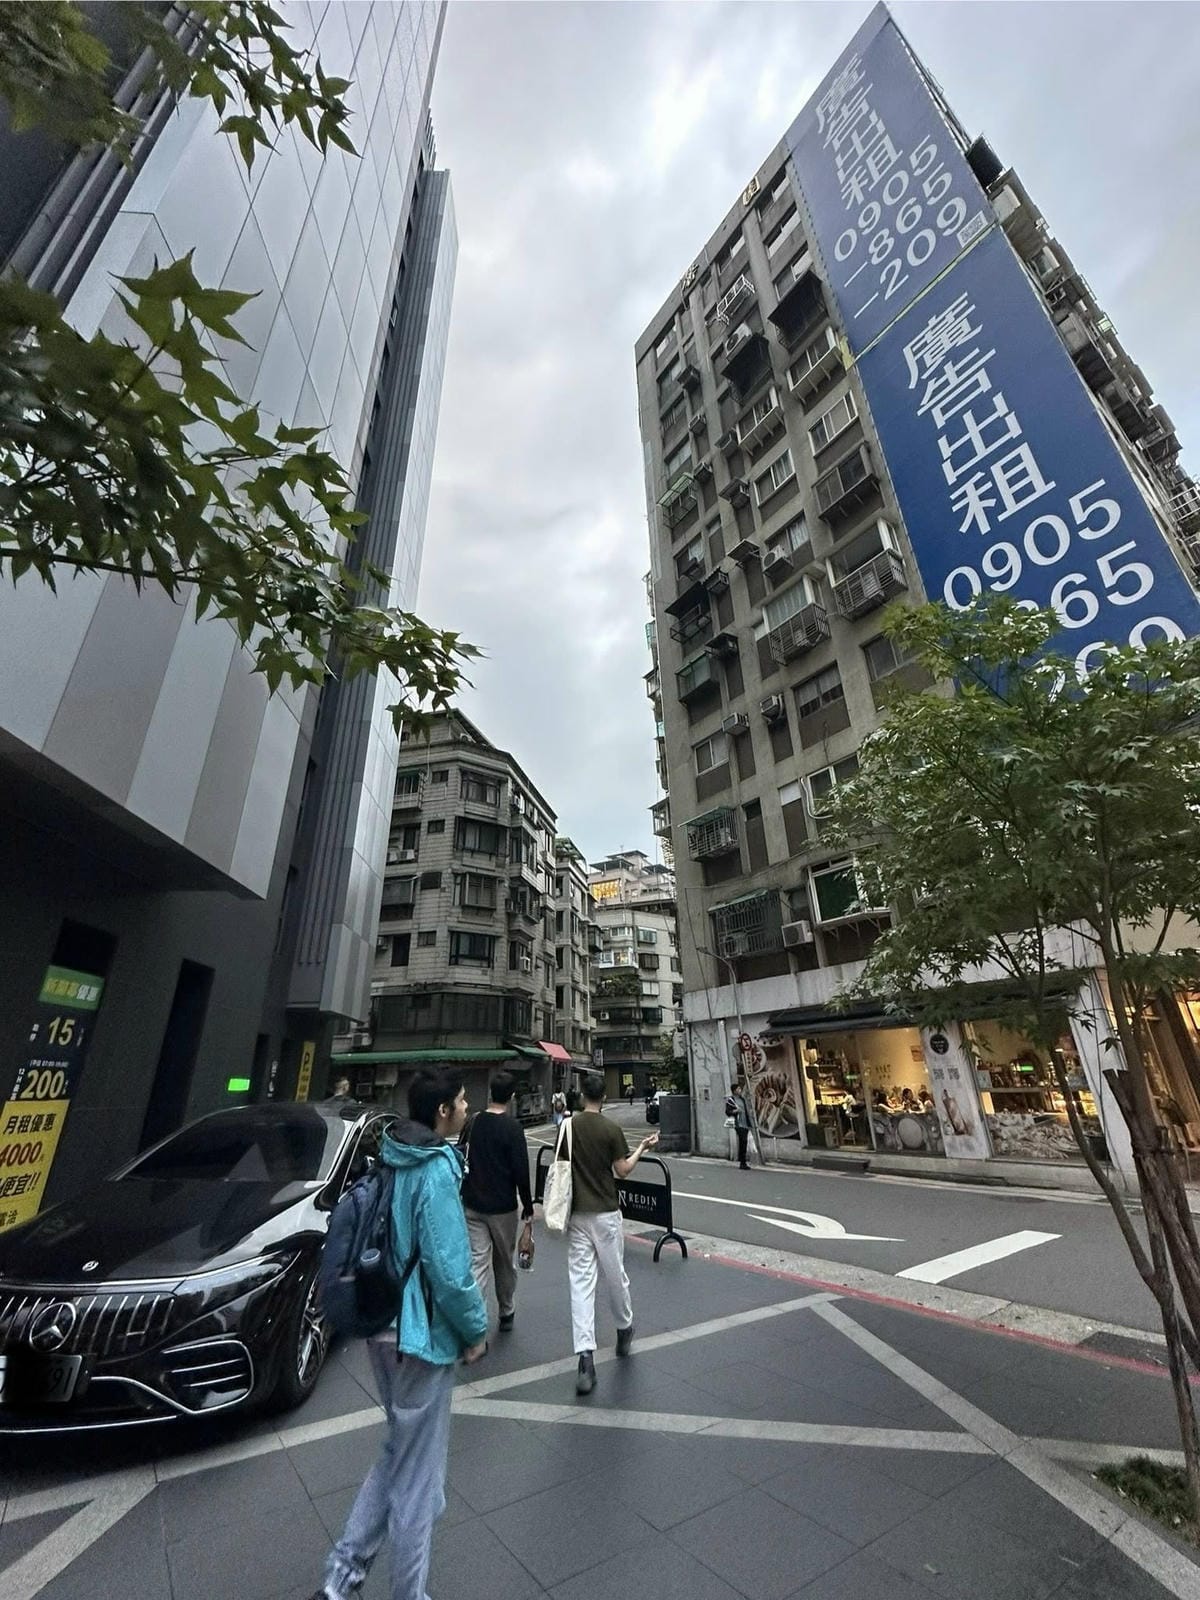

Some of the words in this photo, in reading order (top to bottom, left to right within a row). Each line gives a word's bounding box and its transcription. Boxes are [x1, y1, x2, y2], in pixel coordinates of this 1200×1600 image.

[816, 53, 903, 210] 廣告出租
[834, 134, 938, 262] 0905
[903, 291, 1056, 535] 廣告出租
[943, 478, 1121, 613] 0905
[48, 1016, 75, 1046] 15
[20, 1069, 65, 1099] 200
[3, 1113, 56, 1135] 月租優惠
[0, 1172, 42, 1198] 便宜!!
